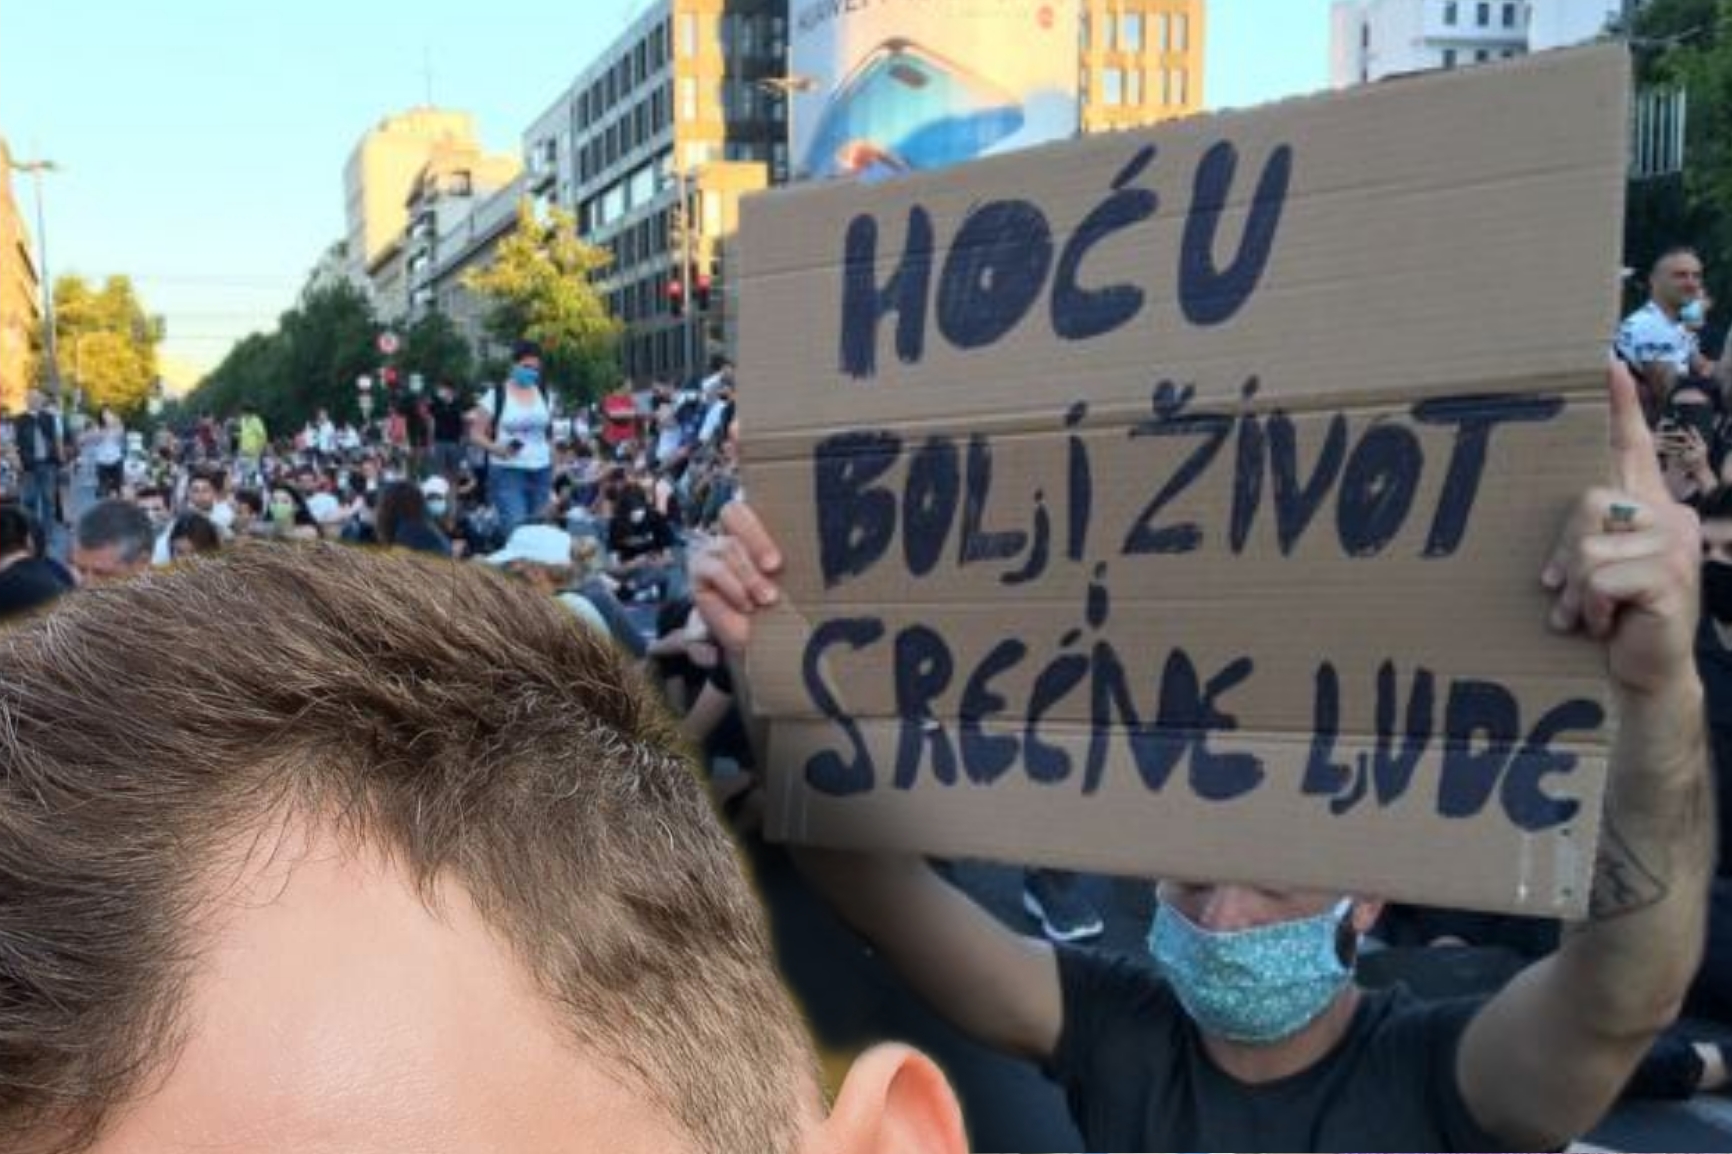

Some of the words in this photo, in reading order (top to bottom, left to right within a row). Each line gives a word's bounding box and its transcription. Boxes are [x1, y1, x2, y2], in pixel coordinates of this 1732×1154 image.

[838, 140, 1292, 378] HOĆU
[1121, 375, 1565, 558] ŽIVOT
[803, 616, 1265, 800] SREĆNE
[1301, 658, 1605, 832] LJUDE
